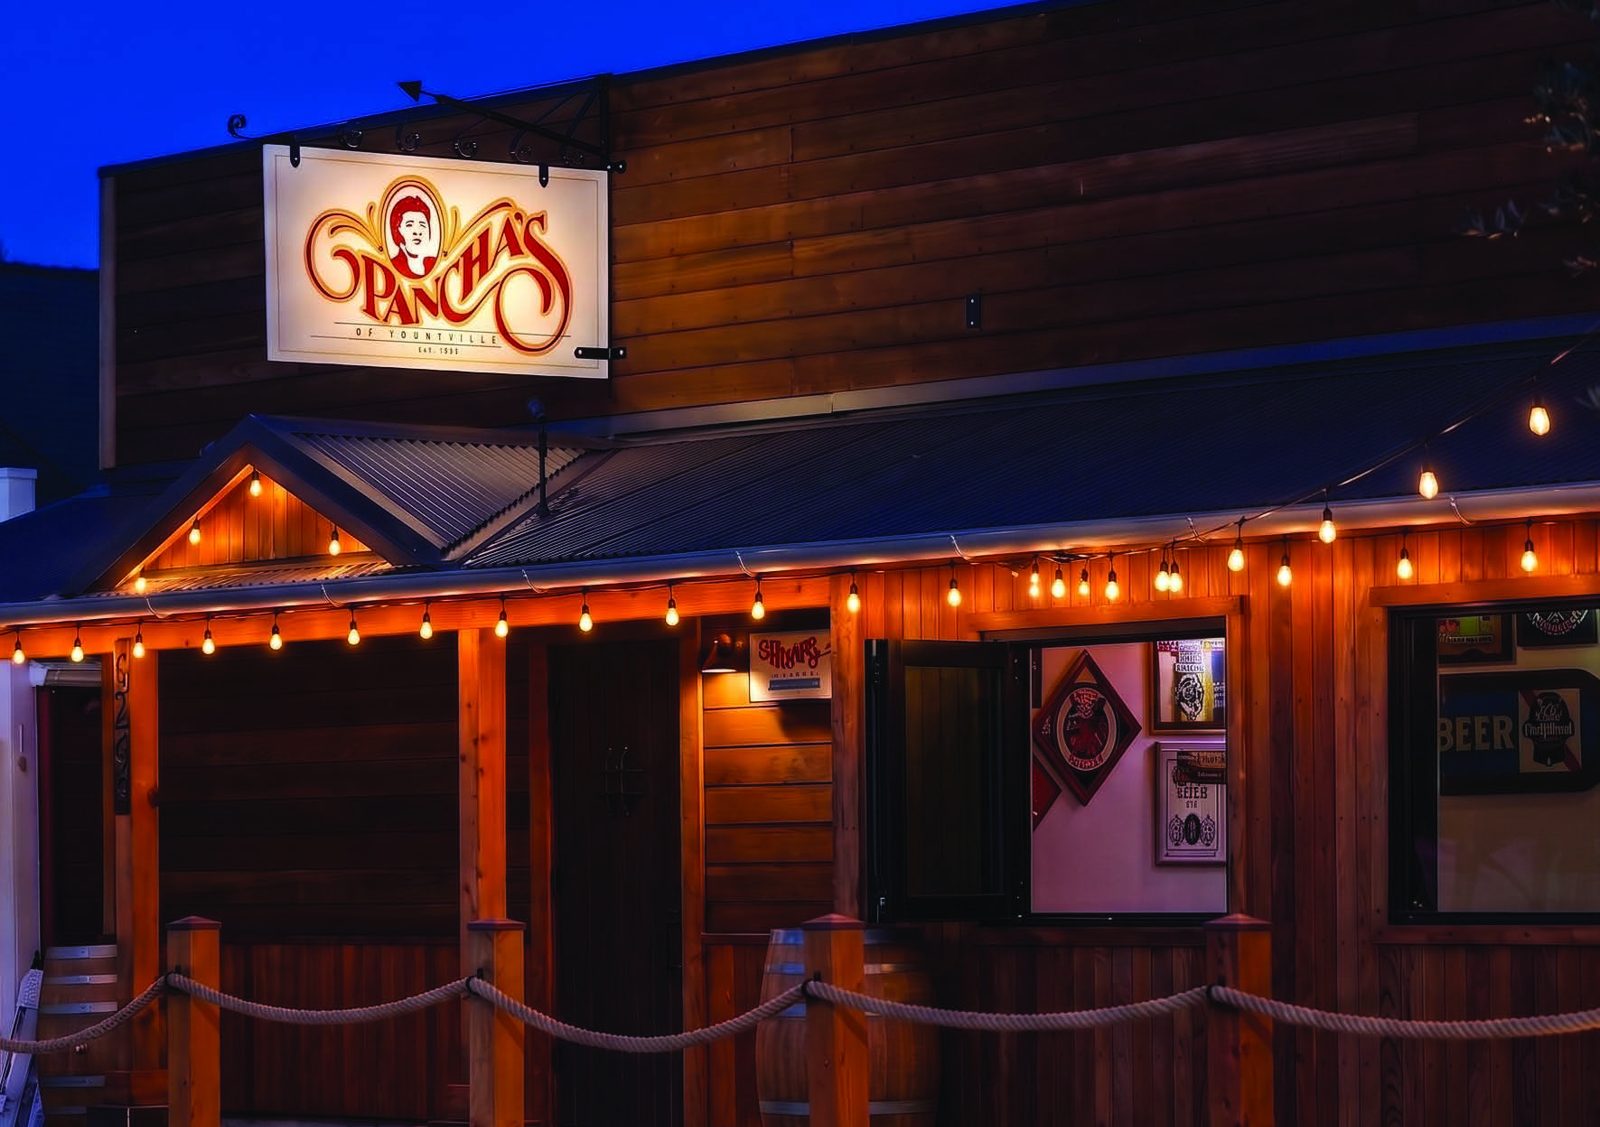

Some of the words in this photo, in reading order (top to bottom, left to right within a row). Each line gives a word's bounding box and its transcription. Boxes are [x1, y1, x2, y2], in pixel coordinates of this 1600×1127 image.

[304, 198, 573, 357] PANCHA'S
[355, 327, 373, 337] OF
[389, 331, 497, 345] YOUNTVILLE
[1439, 715, 1515, 753] BEER
